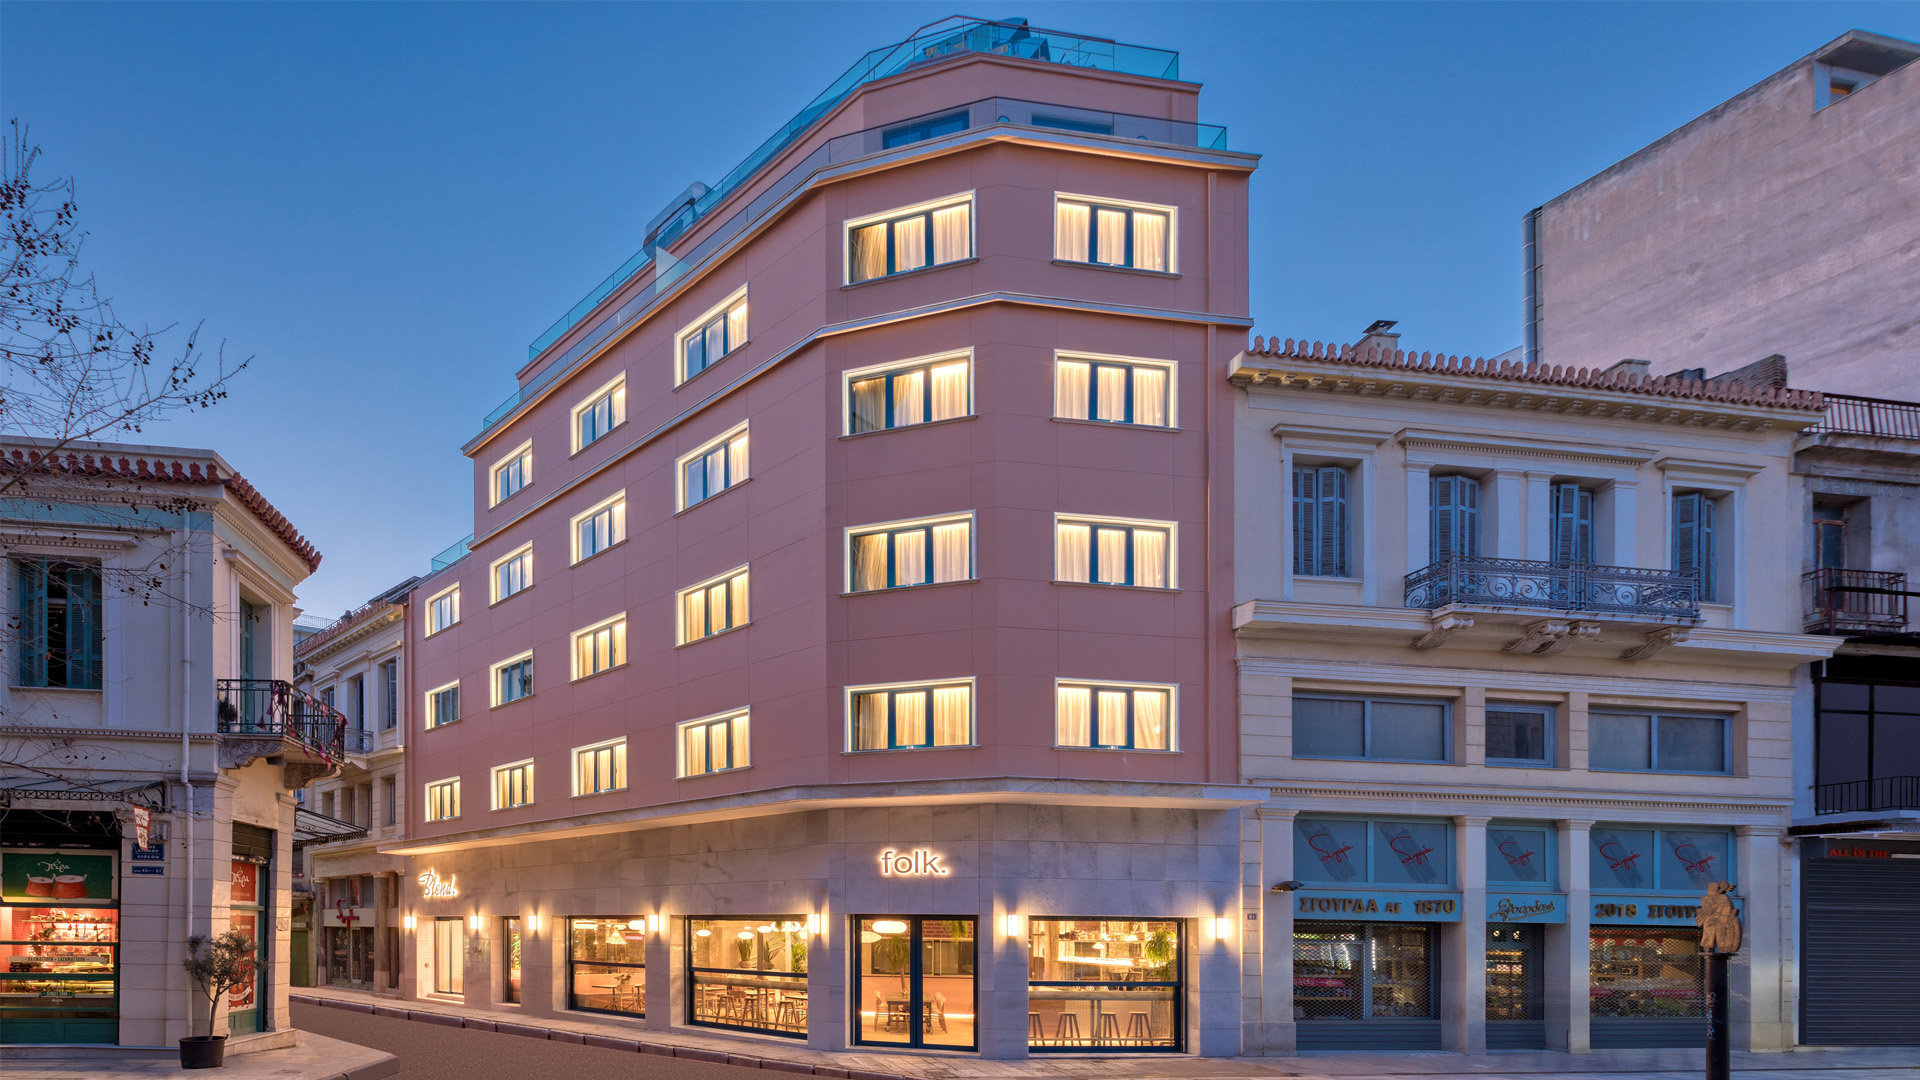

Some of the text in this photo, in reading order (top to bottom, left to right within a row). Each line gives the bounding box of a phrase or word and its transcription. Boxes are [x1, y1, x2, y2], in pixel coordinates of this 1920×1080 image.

[881, 850, 946, 873] folk.
[1829, 848, 1850, 857] ALL
[1868, 850, 1890, 858] THE
[418, 869, 456, 896] Blend.
[1299, 897, 1456, 914] ΣΓΟΥΡΔΑ ΑΕ 1870
[1595, 903, 1702, 919] 2018 ΣΓΟΥΡ
